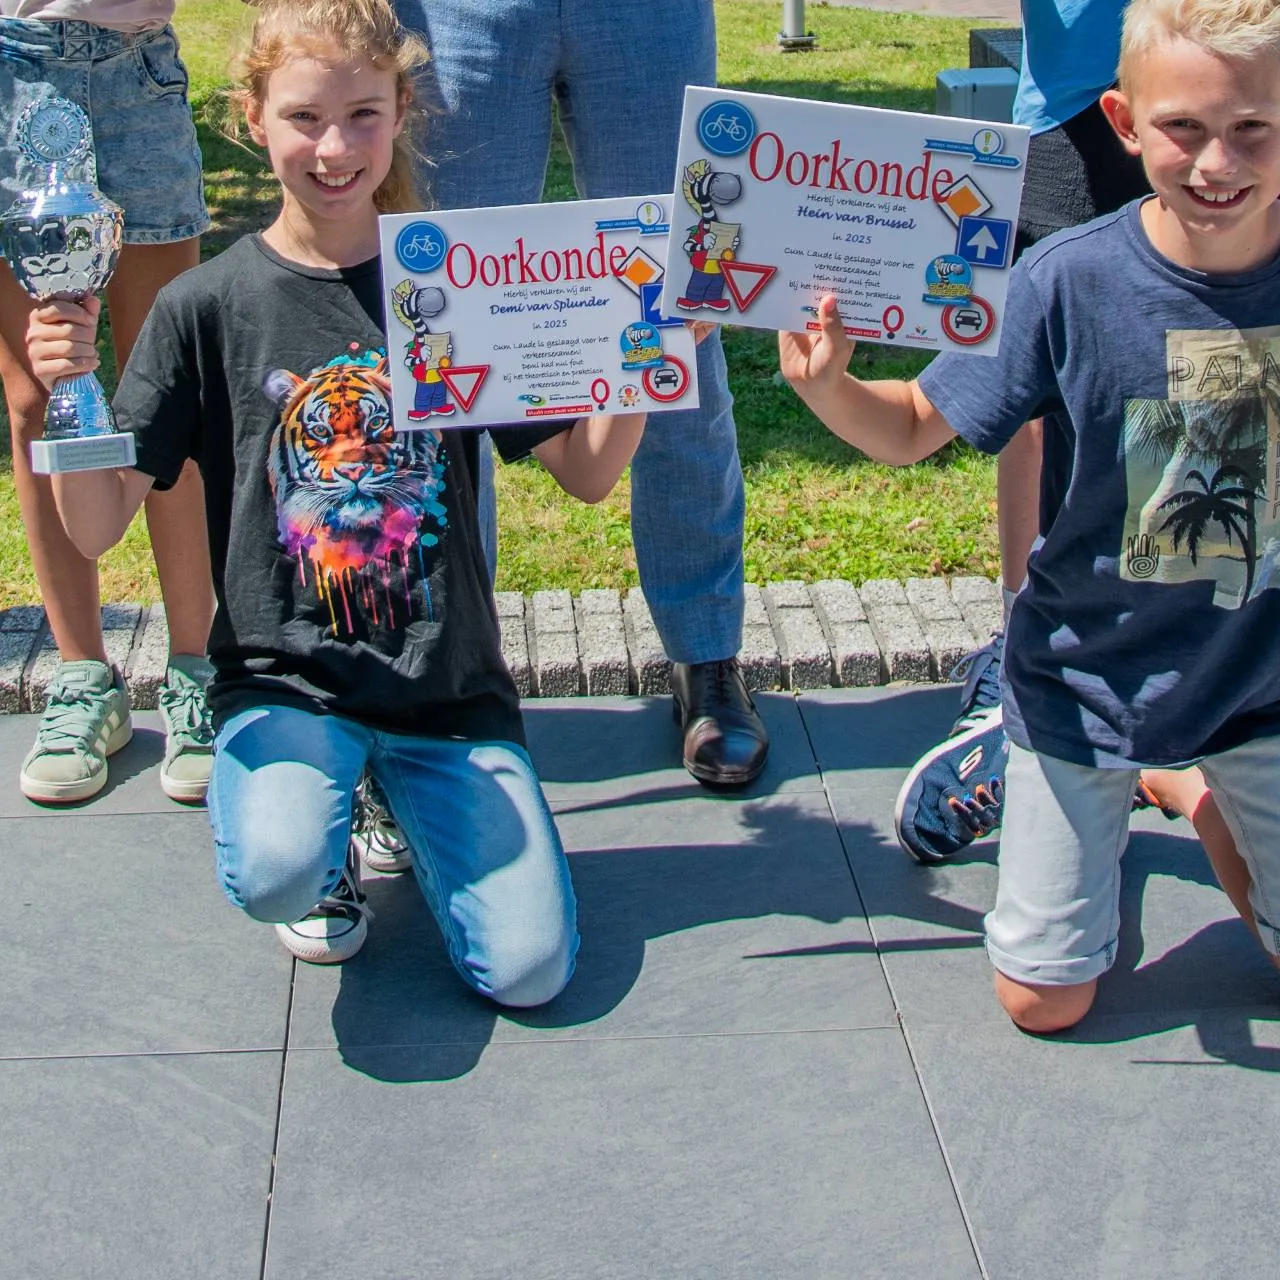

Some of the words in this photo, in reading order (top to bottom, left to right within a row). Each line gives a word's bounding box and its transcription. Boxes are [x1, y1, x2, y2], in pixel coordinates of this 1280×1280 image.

[748, 131, 954, 203] Oorkonde
[807, 194, 834, 206] Hierbij
[836, 198, 876, 208] verklaren
[878, 203, 890, 213] wij
[893, 204, 906, 212] dat
[798, 206, 833, 219] Hein
[836, 212, 865, 223] van
[865, 215, 916, 230] Brussel
[845, 234, 871, 244] 2025
[445, 232, 628, 289] Oorkonde
[784, 248, 804, 256] Cum
[807, 250, 832, 260] Laude
[843, 255, 881, 266] geslaagd
[902, 261, 914, 269] het
[865, 279, 880, 288] fout
[504, 289, 527, 299] Hierbij
[530, 288, 564, 296] verklaren
[567, 286, 577, 295] wij
[813, 284, 852, 295] theoretisch
[866, 291, 901, 300] praktisch
[490, 303, 524, 314] Demi
[527, 302, 552, 311] van
[554, 296, 609, 312] Splunder
[544, 320, 567, 329] 2025
[514, 341, 536, 349] Laude
[546, 337, 579, 349] geslaagd
[570, 359, 584, 367] fout
[525, 371, 560, 379] theoretisch
